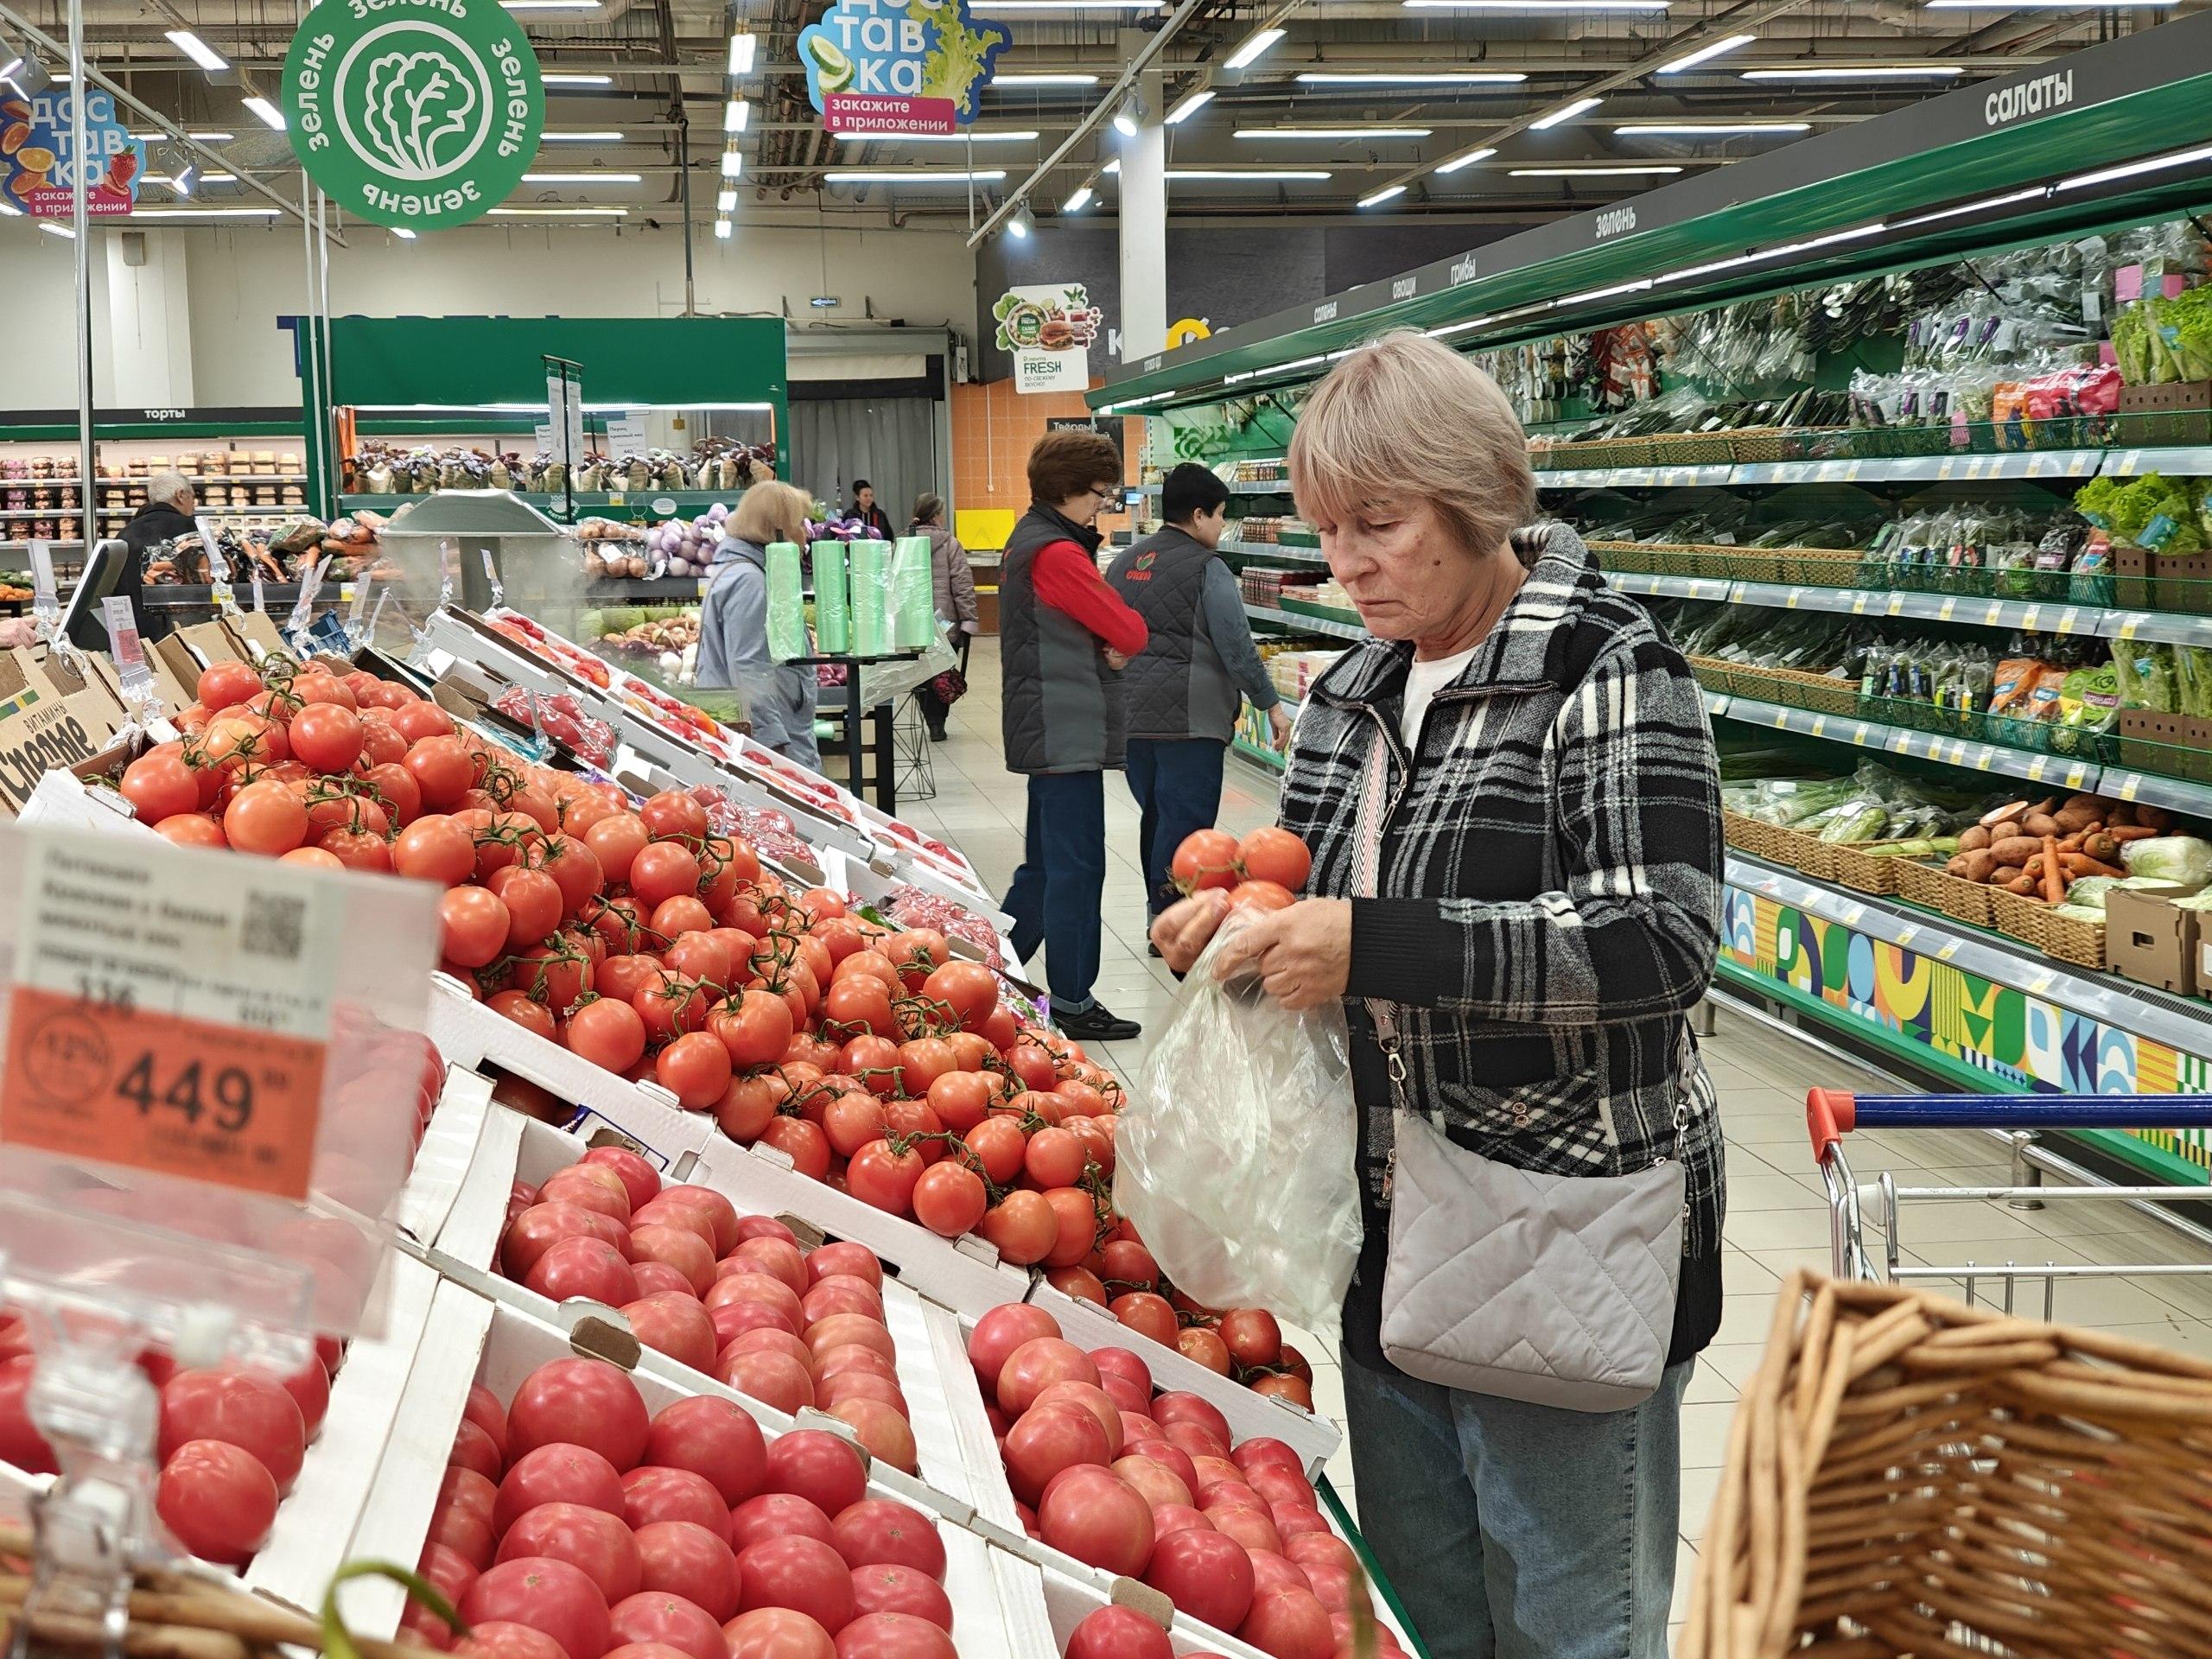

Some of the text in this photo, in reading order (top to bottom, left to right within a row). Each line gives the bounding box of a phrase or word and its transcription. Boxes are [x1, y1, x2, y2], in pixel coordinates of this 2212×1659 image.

[834, 16, 925, 53] тав
[299, 34, 335, 151] зелень
[860, 58, 922, 93] ка
[492, 38, 529, 157] зелень
[832, 98, 910, 112] закажите
[1985, 69, 2073, 125] салаты
[832, 117, 948, 131] в приложении
[362, 181, 481, 216] зелень
[1596, 207, 1637, 238] зелень
[1393, 276, 1417, 299] овощи
[1450, 254, 1476, 286] грибы
[1023, 360, 1062, 374] FRESH
[143, 409, 186, 421] торты
[23, 699, 68, 734] ВИТАМИНЫ
[116, 1047, 255, 1133] 449
